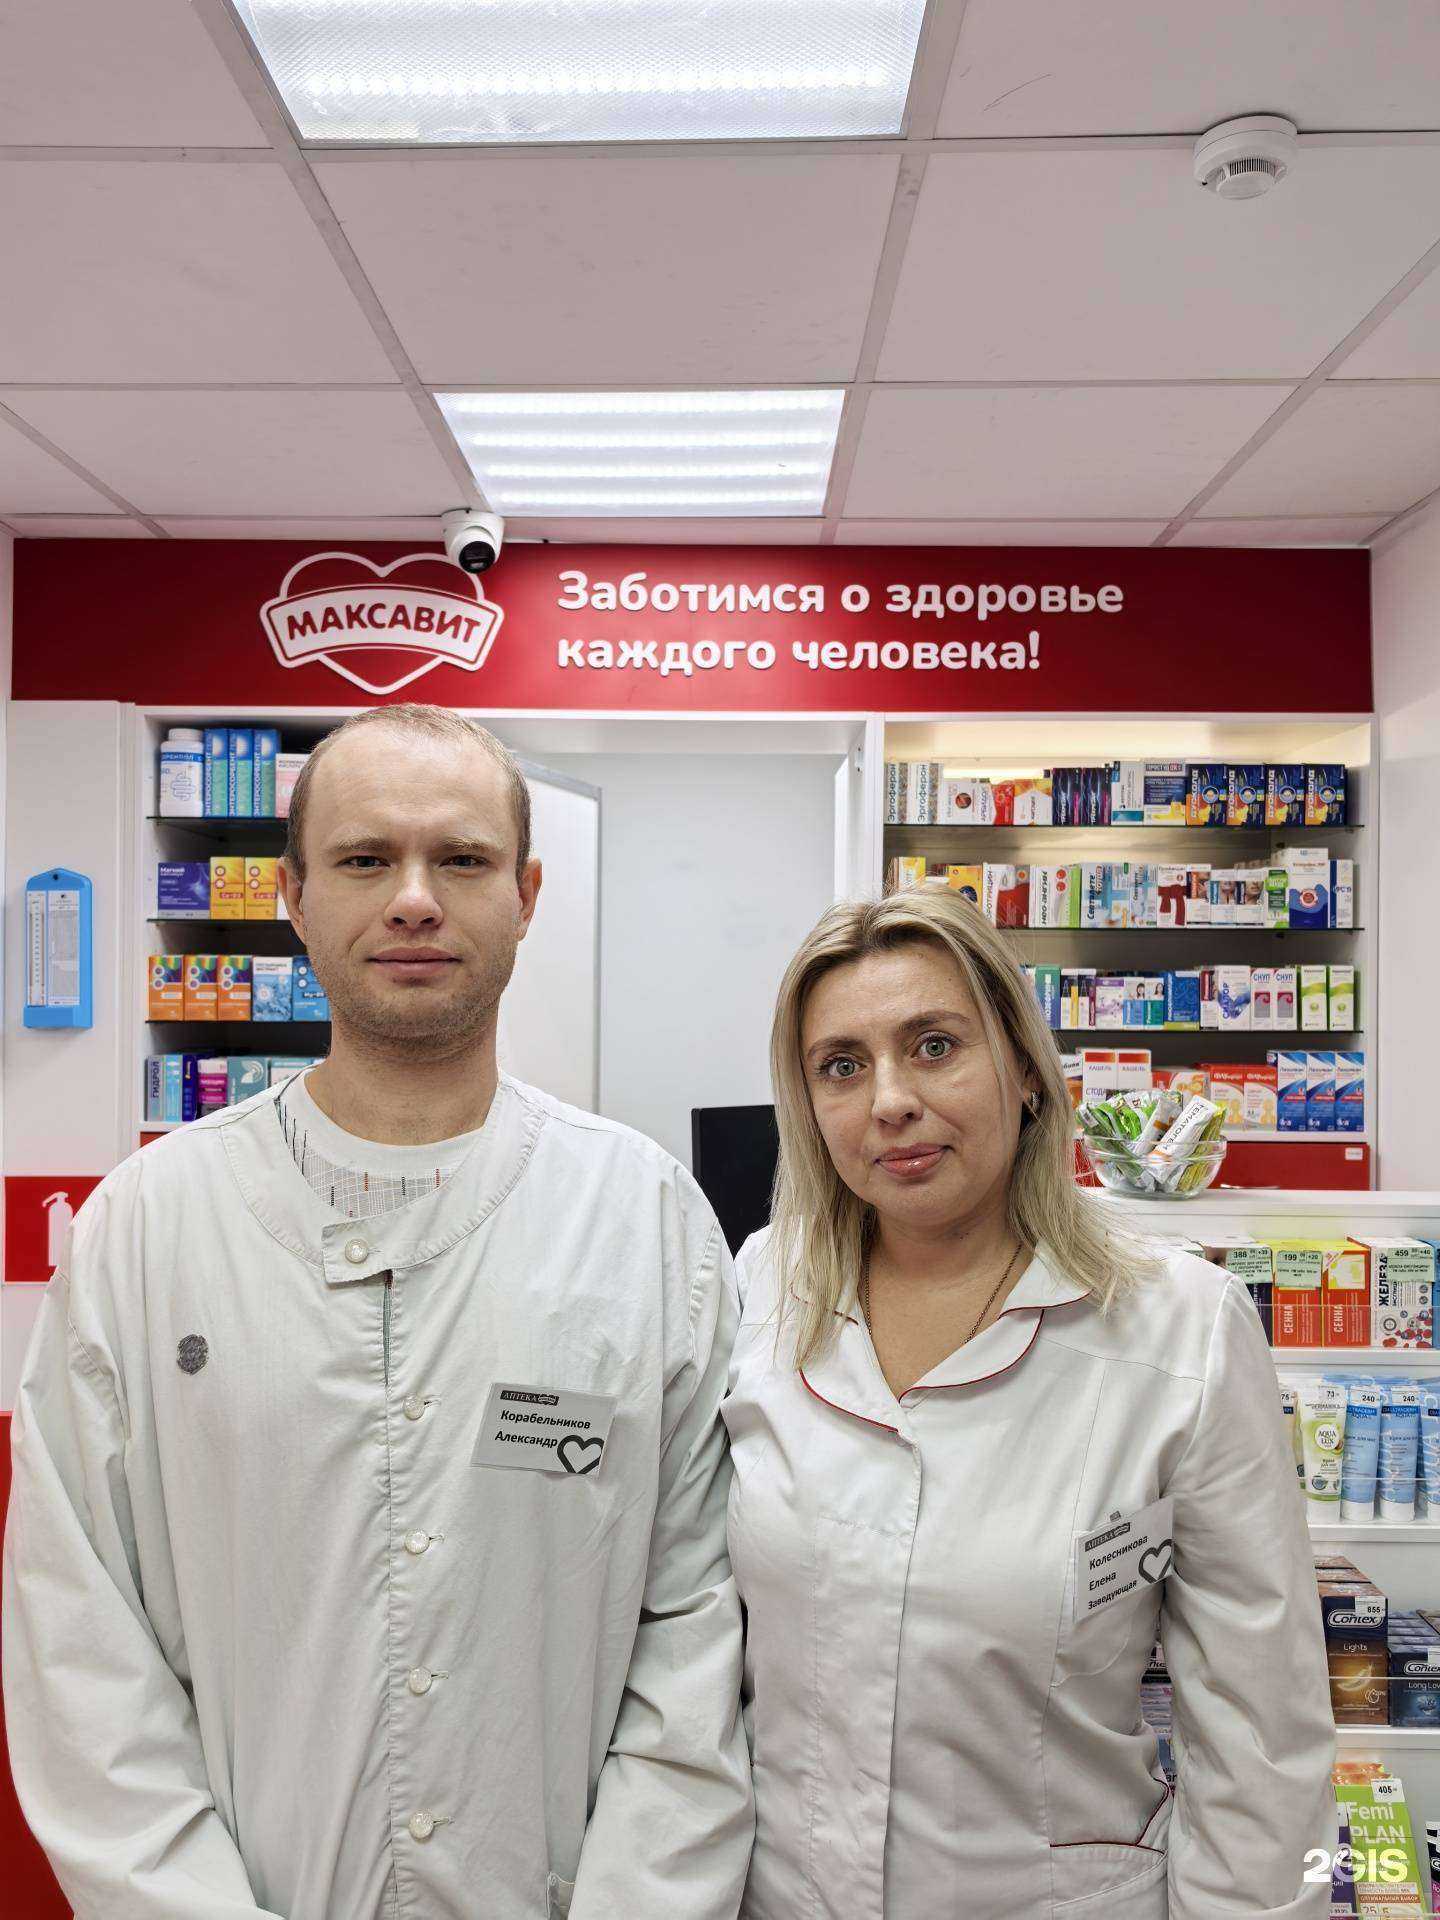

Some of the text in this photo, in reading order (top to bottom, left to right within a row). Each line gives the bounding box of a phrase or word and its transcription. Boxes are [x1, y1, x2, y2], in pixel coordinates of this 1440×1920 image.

[556, 570, 1125, 622] Заботимся о здоровье
[286, 602, 481, 644] МАКСАВИТ
[557, 630, 1042, 678] каждого человека!
[888, 763, 896, 822] Эргоферон
[918, 764, 927, 822] Эргоферон
[1253, 973, 1270, 982] СНУП
[1276, 973, 1293, 982] СНУП
[1394, 1249, 1409, 1257] 459
[1284, 1304, 1293, 1333] СЕННА
[1333, 1304, 1343, 1333] СЕННА
[503, 1391, 537, 1400] АПТЕКА
[500, 1409, 591, 1429] Корабельников
[494, 1430, 558, 1449] Александр
[1318, 1430, 1336, 1439] AQUA
[1089, 1535, 1149, 1571] Колесникова
[1089, 1571, 1117, 1591] Елена
[1087, 1580, 1138, 1610] Заведующая
[1332, 1611, 1378, 1625] Contex
[1343, 1643, 1368, 1653] Lights
[1408, 1682, 1427, 1691] Long
[1378, 1786, 1392, 1794] 405
[1347, 1802, 1394, 1820] Femi
[1351, 1825, 1406, 1844] PLAN
